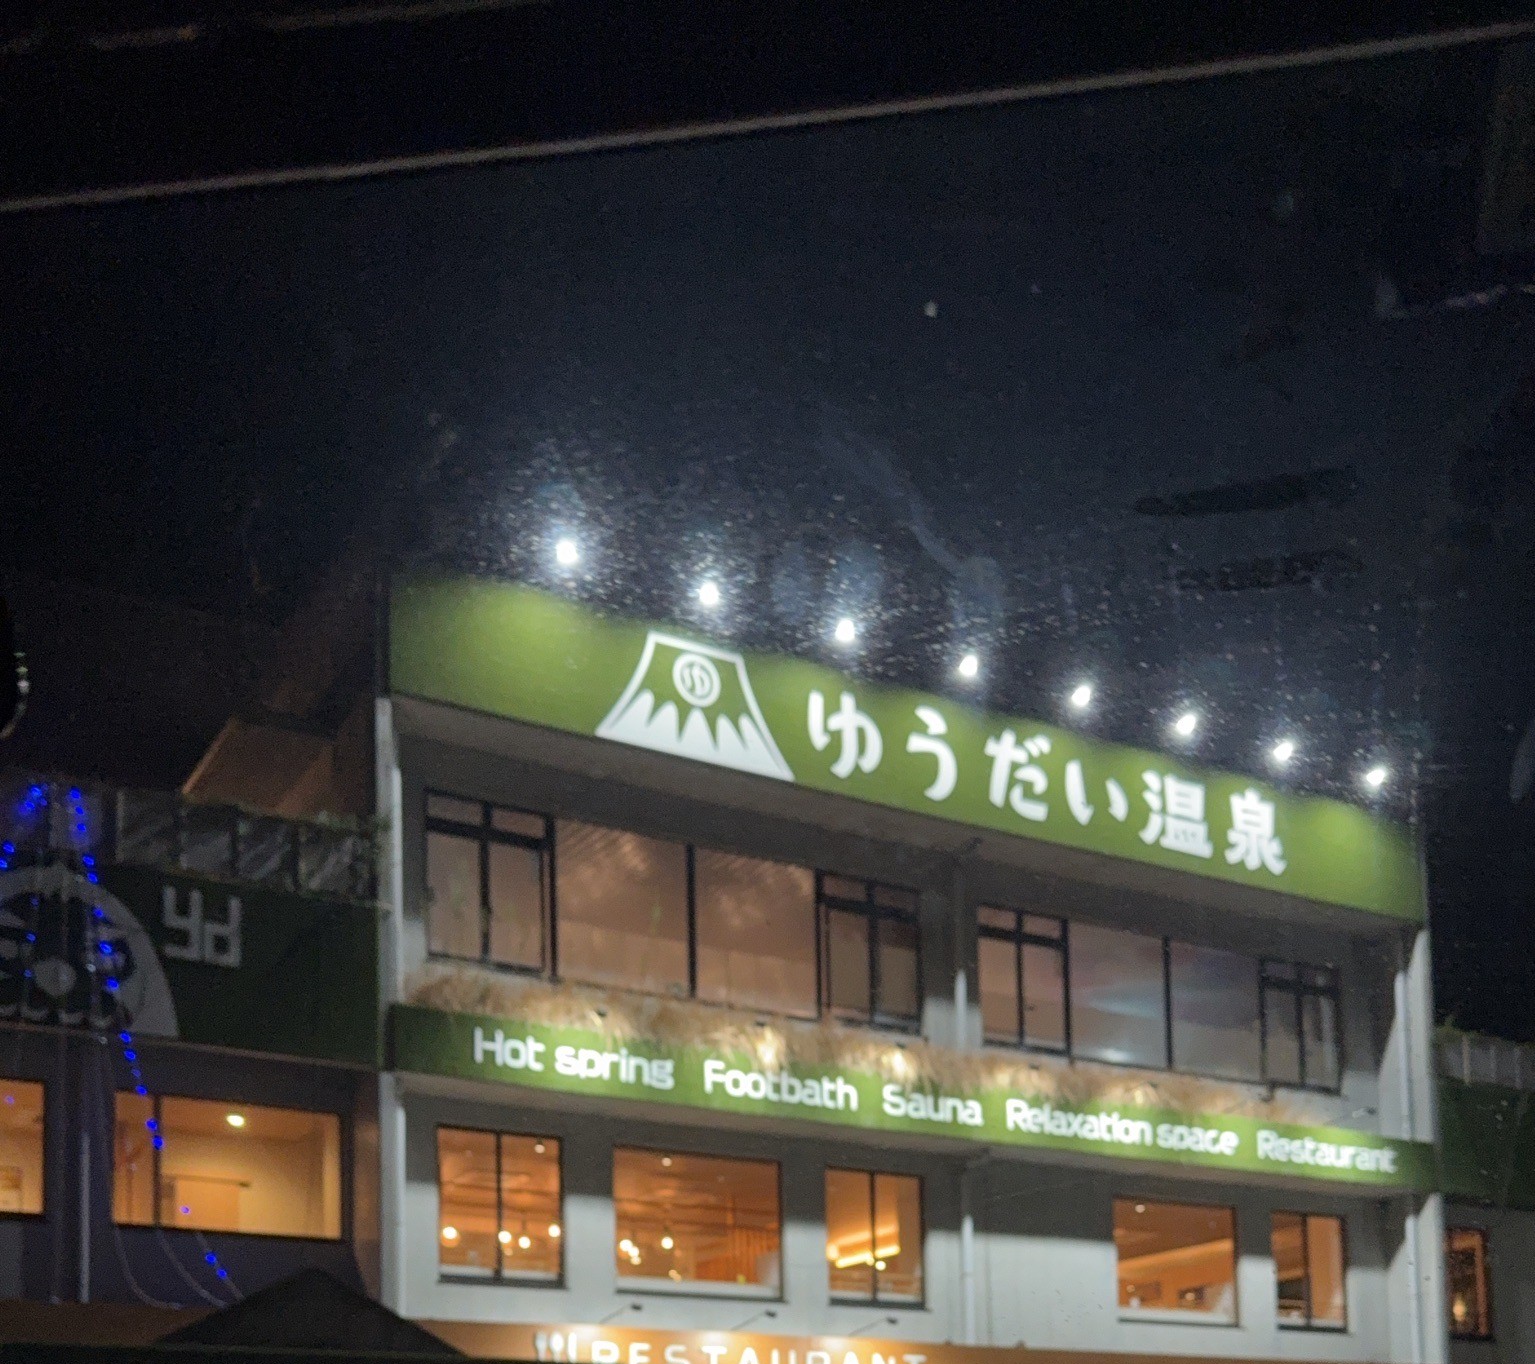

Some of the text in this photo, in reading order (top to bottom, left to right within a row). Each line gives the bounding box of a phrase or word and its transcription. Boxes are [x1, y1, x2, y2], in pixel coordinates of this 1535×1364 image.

[806, 690, 1287, 876] ゆうだい温泉
[473, 1027, 1398, 1174] Hot spring Footbath Sauna Relaxation space Restaurant
